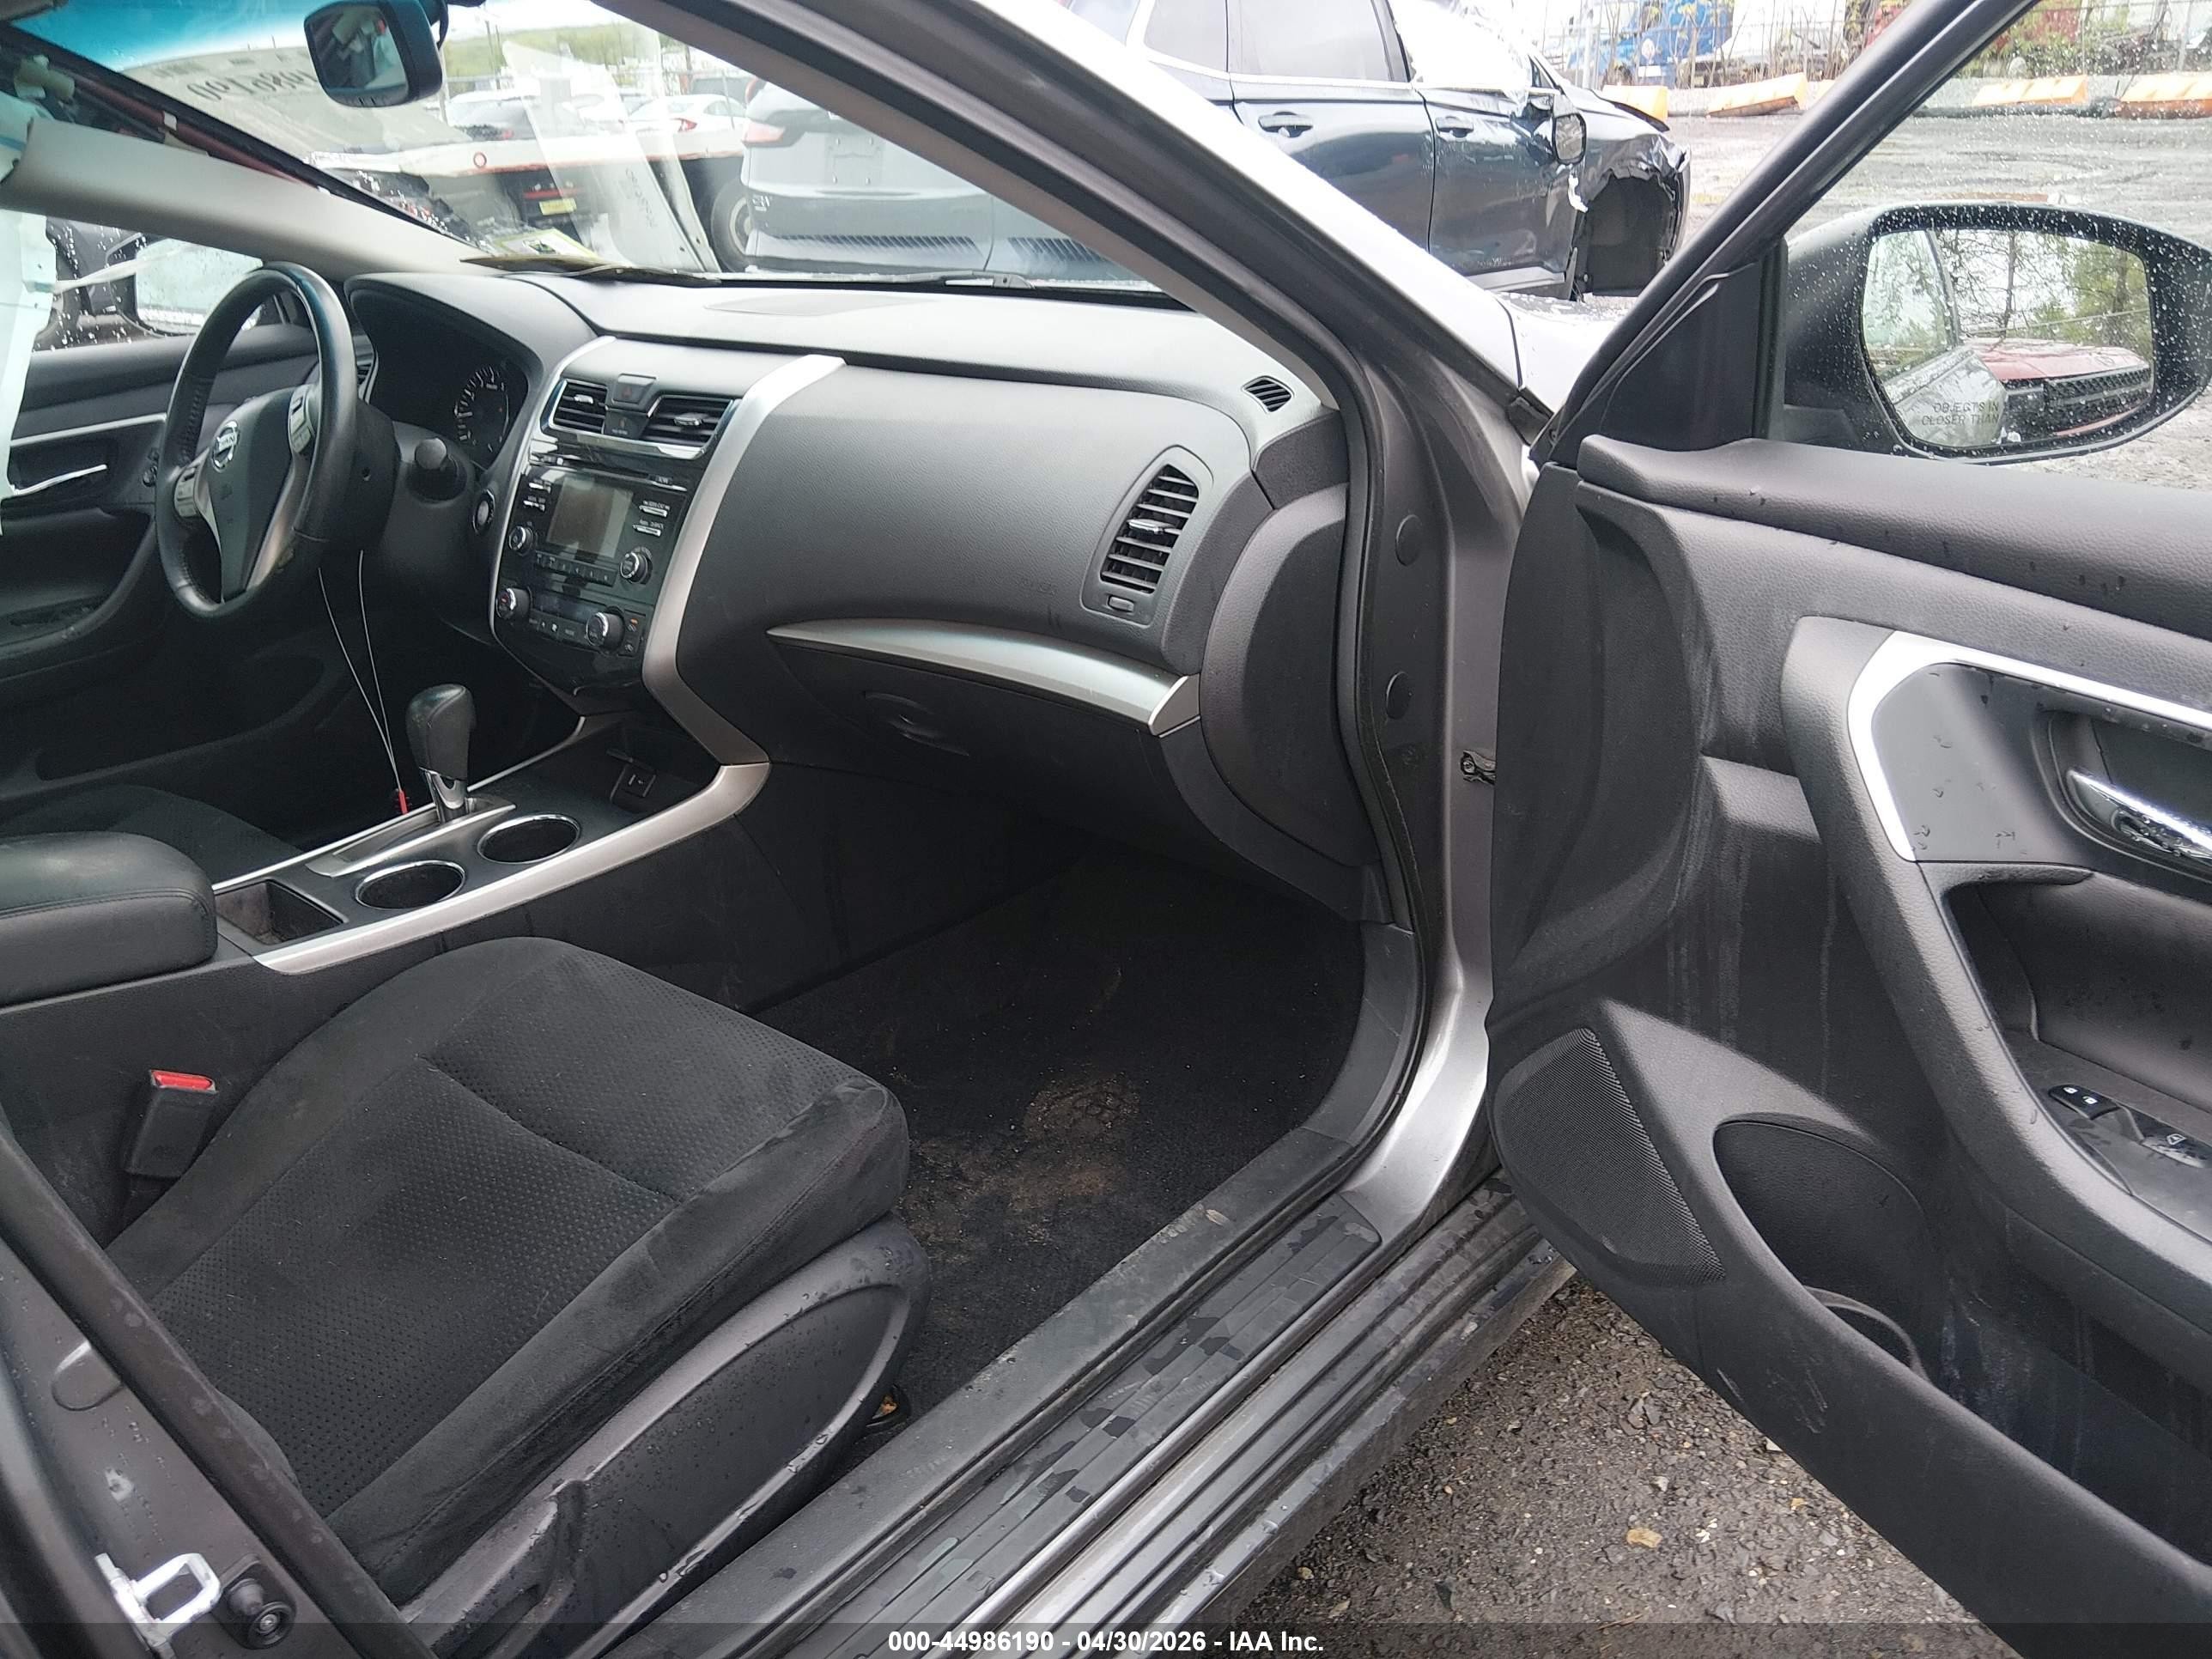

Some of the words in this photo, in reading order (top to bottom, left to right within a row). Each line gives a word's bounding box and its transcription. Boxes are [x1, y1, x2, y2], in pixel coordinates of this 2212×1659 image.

[1933, 402, 1985, 413] OBJECTS
[1988, 401, 1999, 412] IN
[1922, 415, 1966, 426] CLOSER
[1971, 414, 1999, 425] THAN
